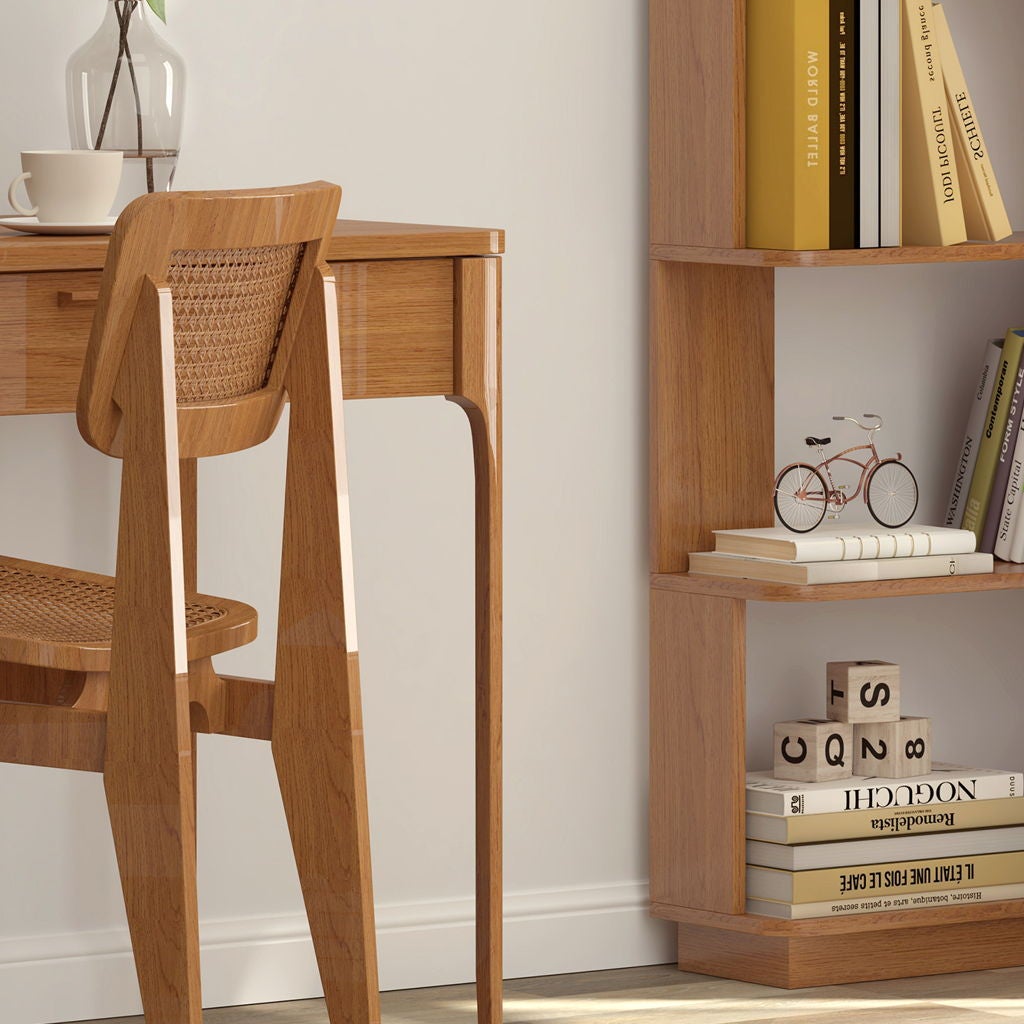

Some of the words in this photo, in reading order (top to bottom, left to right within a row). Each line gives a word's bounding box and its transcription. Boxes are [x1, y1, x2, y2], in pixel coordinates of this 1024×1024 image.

[976, 364, 990, 401] Columbia
[999, 419, 1014, 463] FORM
[945, 436, 974, 526] WASHINGTON
[999, 509, 1012, 542] State
[1008, 459, 1022, 507] Capital
[830, 680, 845, 706] T
[859, 681, 890, 708] S
[780, 735, 808, 765] C
[825, 732, 845, 767] Q
[861, 737, 888, 761] 2
[904, 736, 926, 761] 8
[843, 779, 978, 811] NOGUCHI
[870, 811, 955, 832] Remodelista
[868, 872, 882, 889] LE
[883, 870, 908, 889] FOIS
[910, 868, 932, 885] UNE
[933, 865, 963, 886] ÉTAIT
[965, 863, 975, 879] IL
[839, 873, 867, 895] CAFÉ
[859, 899, 883, 910] petits
[883, 899, 892, 908] et
[892, 897, 910, 907] arts
[910, 893, 949, 907] botanique,
[948, 891, 982, 902] Histoire,
[831, 902, 859, 913] secrets
